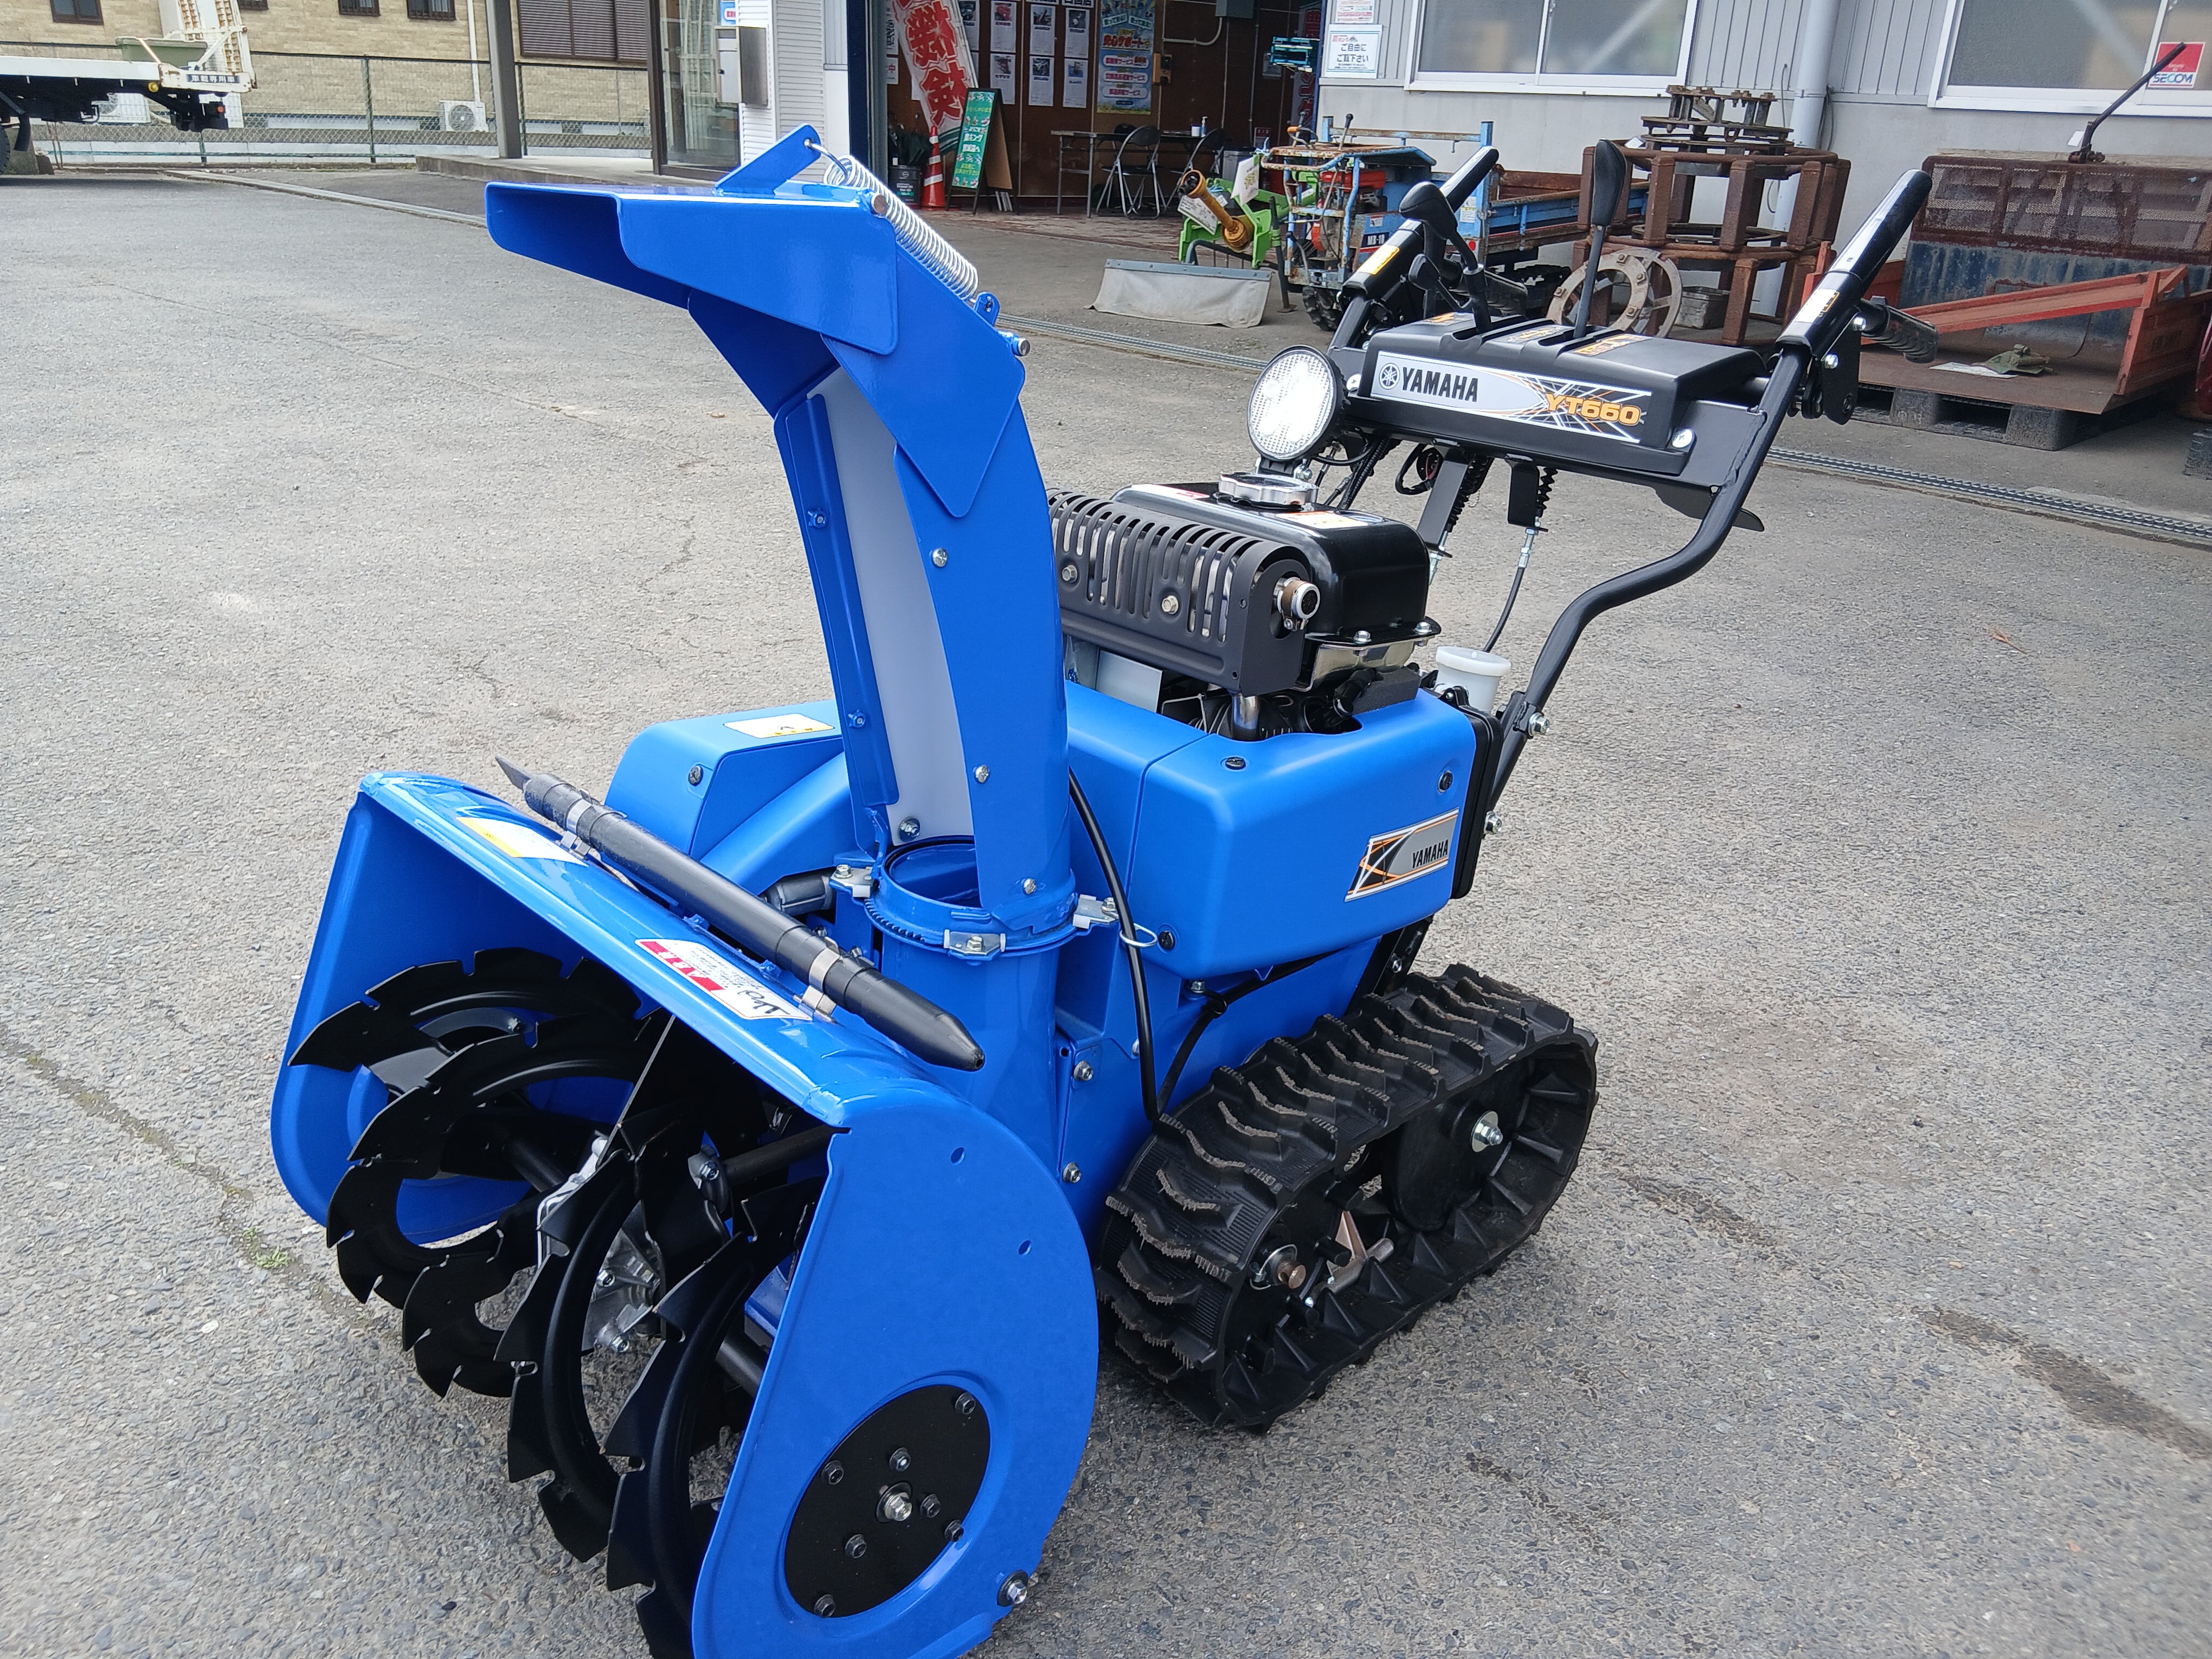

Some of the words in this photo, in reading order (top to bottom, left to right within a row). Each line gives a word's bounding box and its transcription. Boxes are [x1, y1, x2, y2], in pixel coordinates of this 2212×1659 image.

[2152, 73, 2194, 83] SECOM
[1402, 366, 1479, 403] YAMAHA
[1545, 393, 1642, 427] YT660
[1412, 839, 1449, 869] YAMAHA
